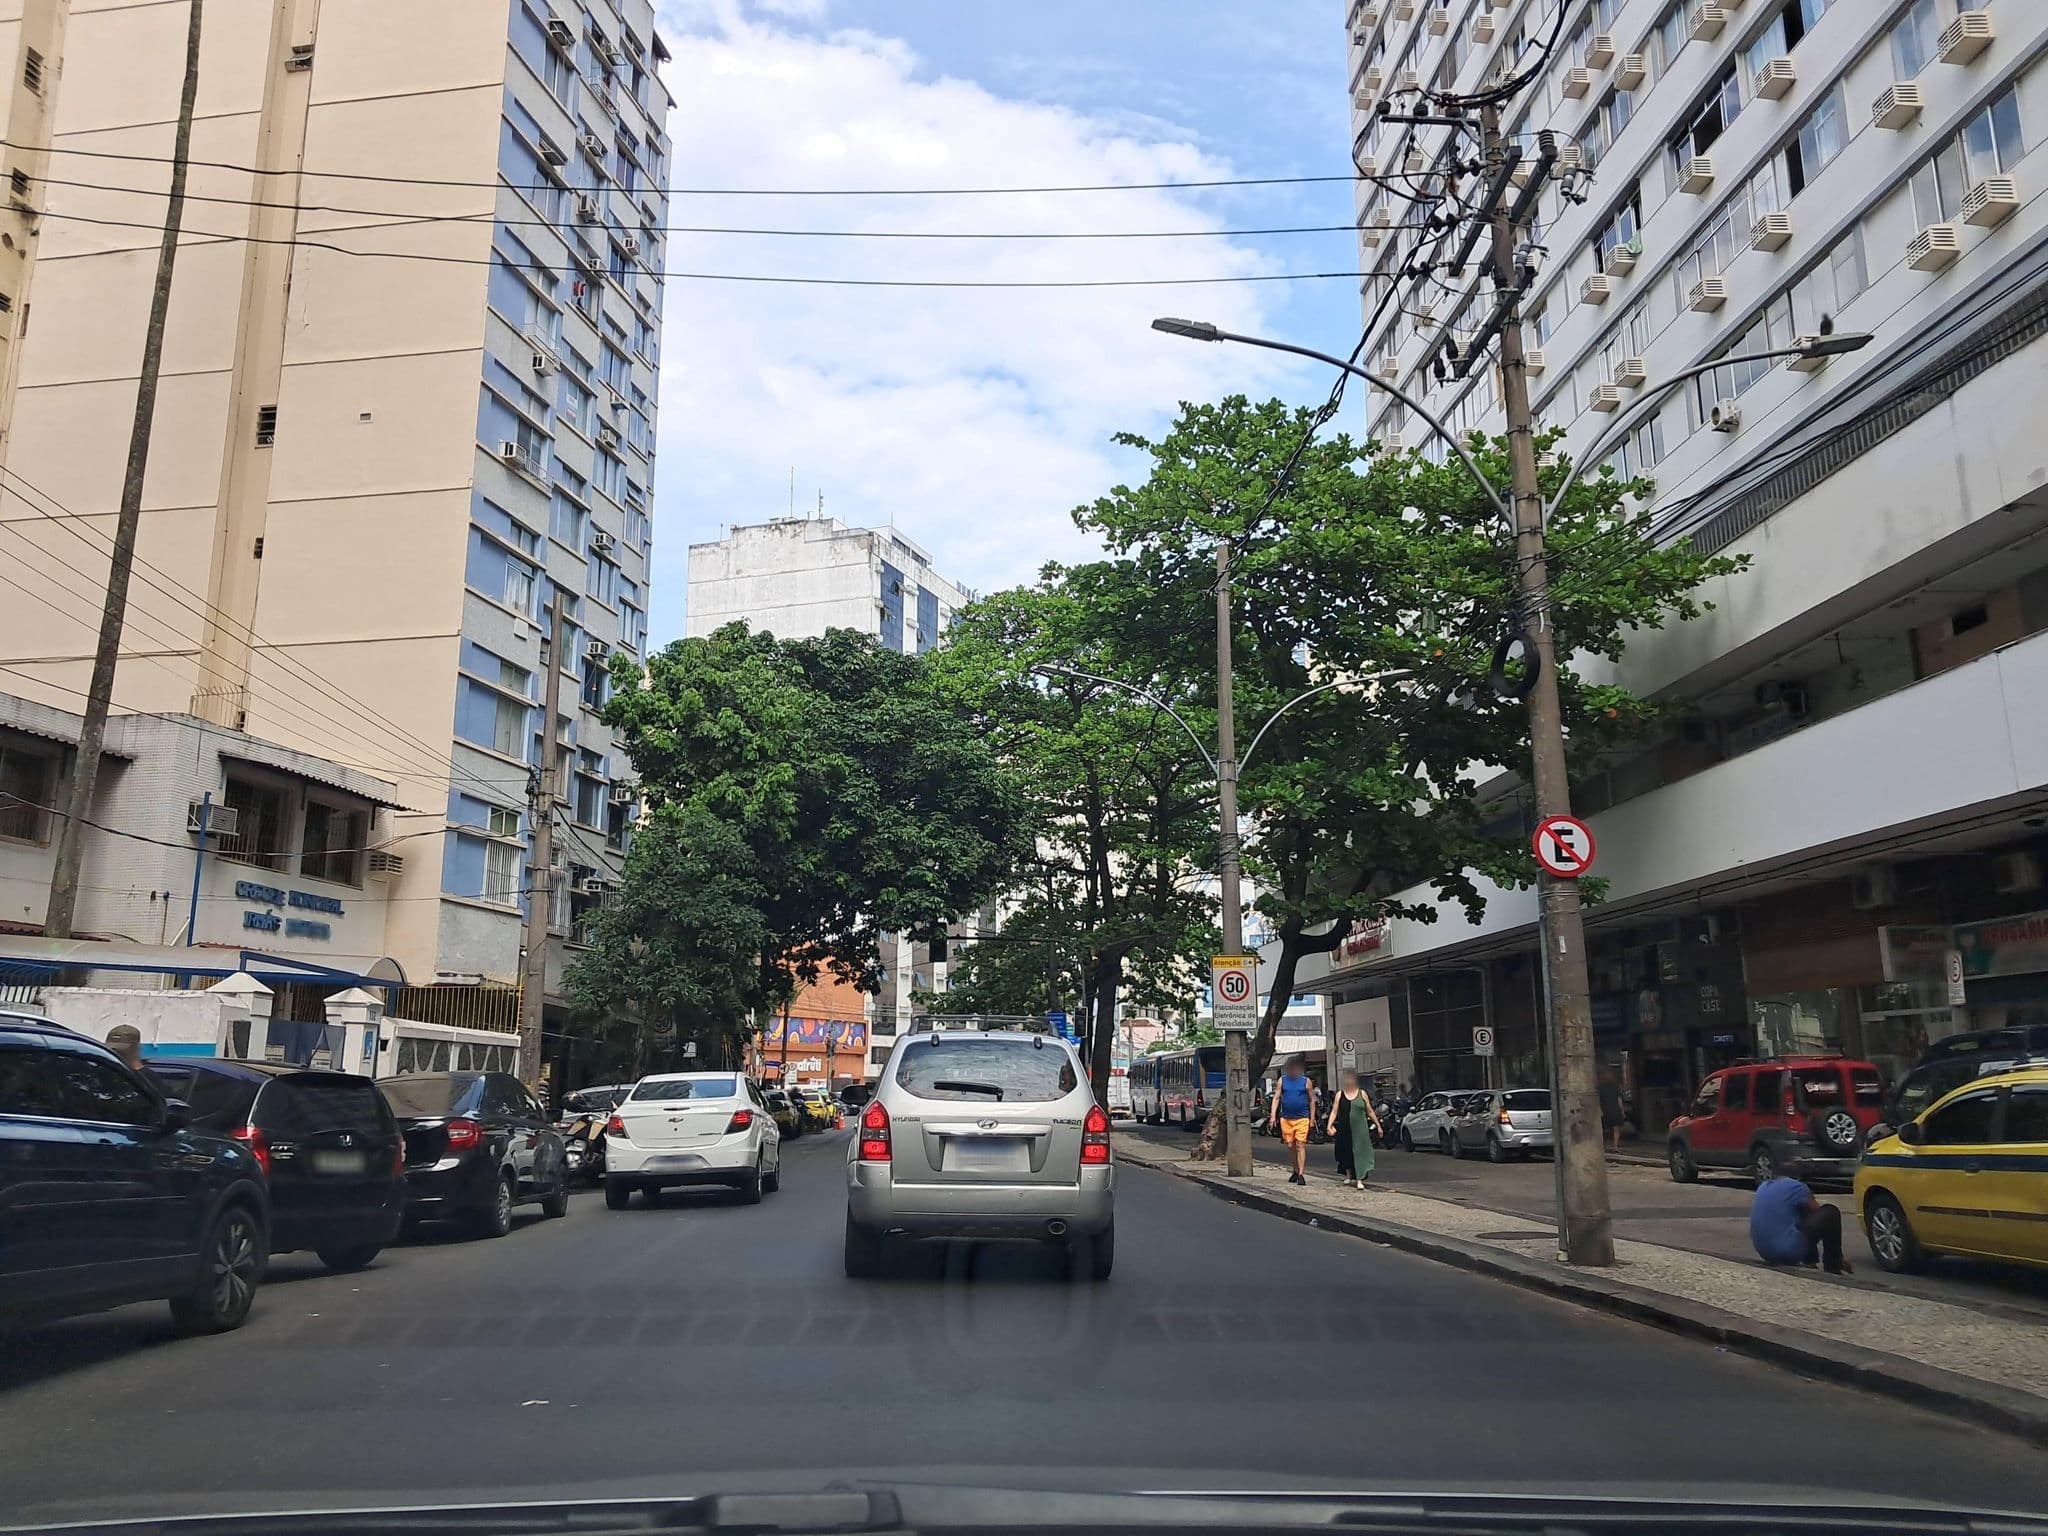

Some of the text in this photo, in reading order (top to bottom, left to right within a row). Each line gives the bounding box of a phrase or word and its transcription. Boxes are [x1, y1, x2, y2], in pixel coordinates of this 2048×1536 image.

[1553, 829, 1576, 863] E
[1214, 959, 1241, 967] Atenção
[1226, 977, 1244, 993] 50
[1215, 1004, 1255, 1012] Fiscalização
[1215, 1011, 1246, 1019] Eletrônica
